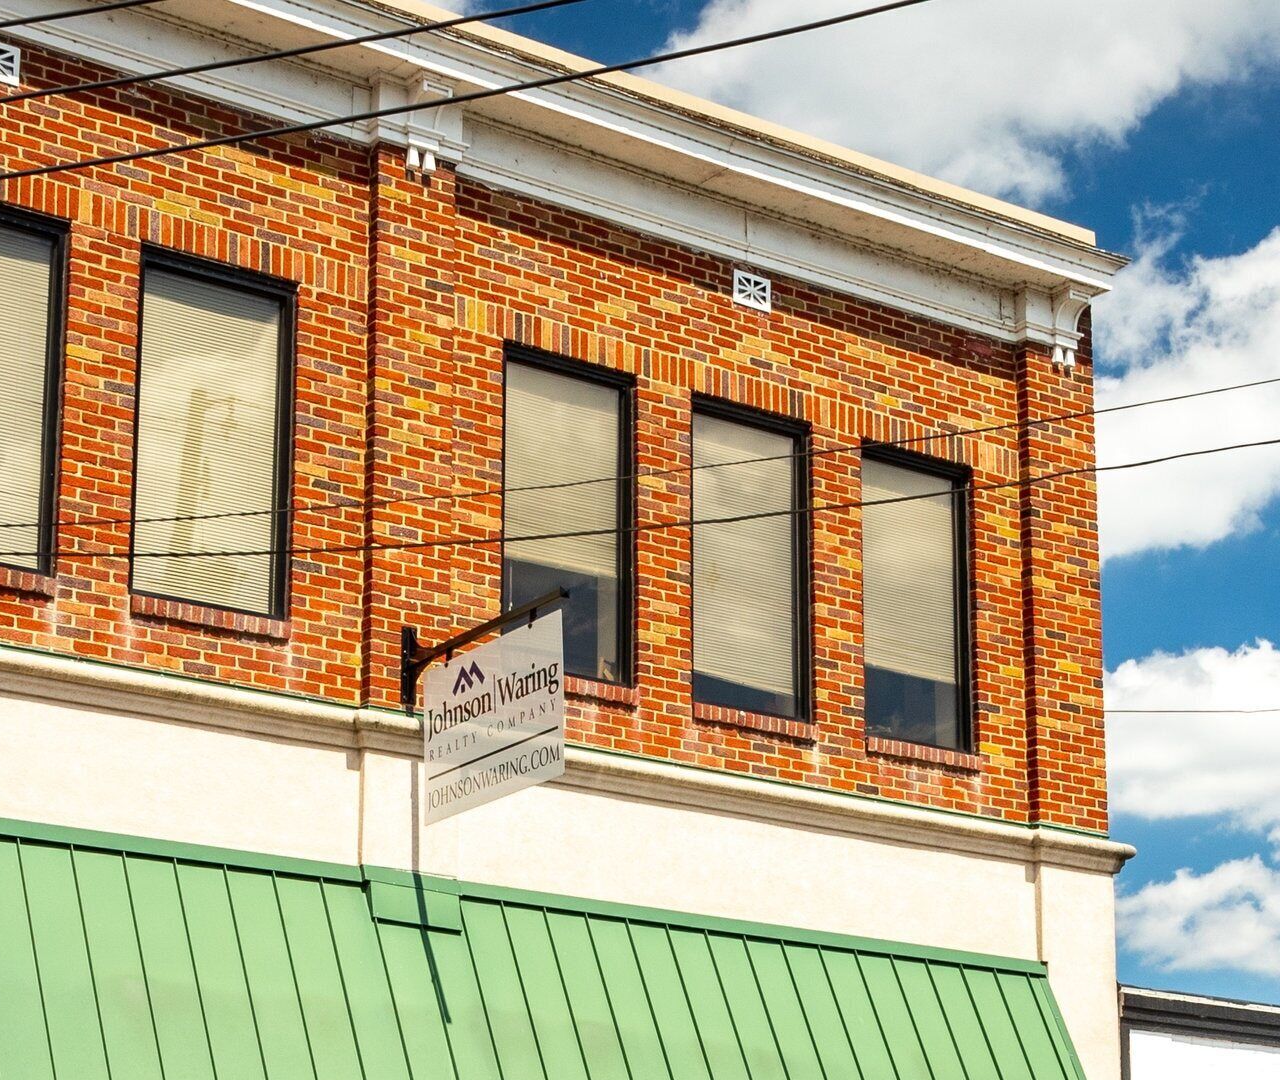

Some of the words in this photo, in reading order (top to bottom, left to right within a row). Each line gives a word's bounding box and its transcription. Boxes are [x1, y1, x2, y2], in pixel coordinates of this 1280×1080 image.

[427, 691, 492, 743] Johnson
[496, 662, 560, 705] Waring
[429, 731, 480, 762] REALTY
[486, 698, 558, 738] COMPANY
[427, 743, 561, 812] JOHNSONWARING.COM
